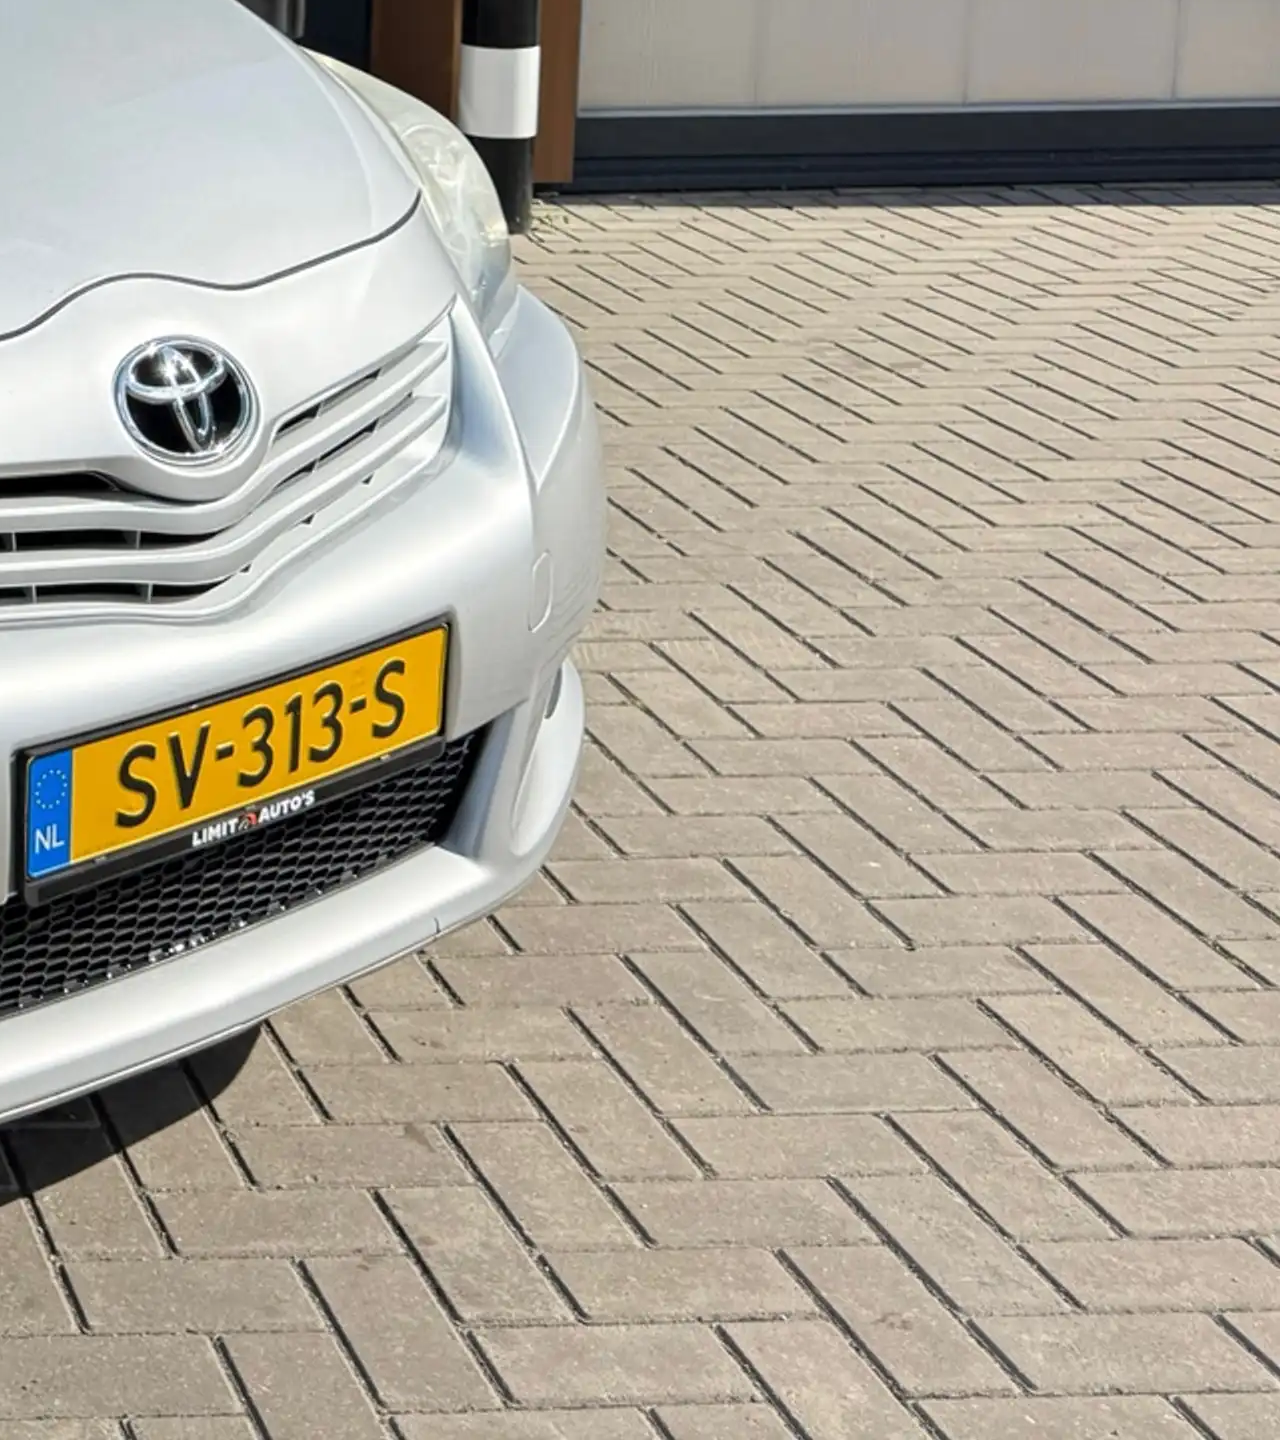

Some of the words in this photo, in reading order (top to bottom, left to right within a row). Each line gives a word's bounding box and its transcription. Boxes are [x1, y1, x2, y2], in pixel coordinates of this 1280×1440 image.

[114, 658, 406, 829] SV-313-S
[34, 823, 66, 855] NL
[192, 819, 239, 847] LIMIT
[258, 790, 316, 824] AUTO'S
